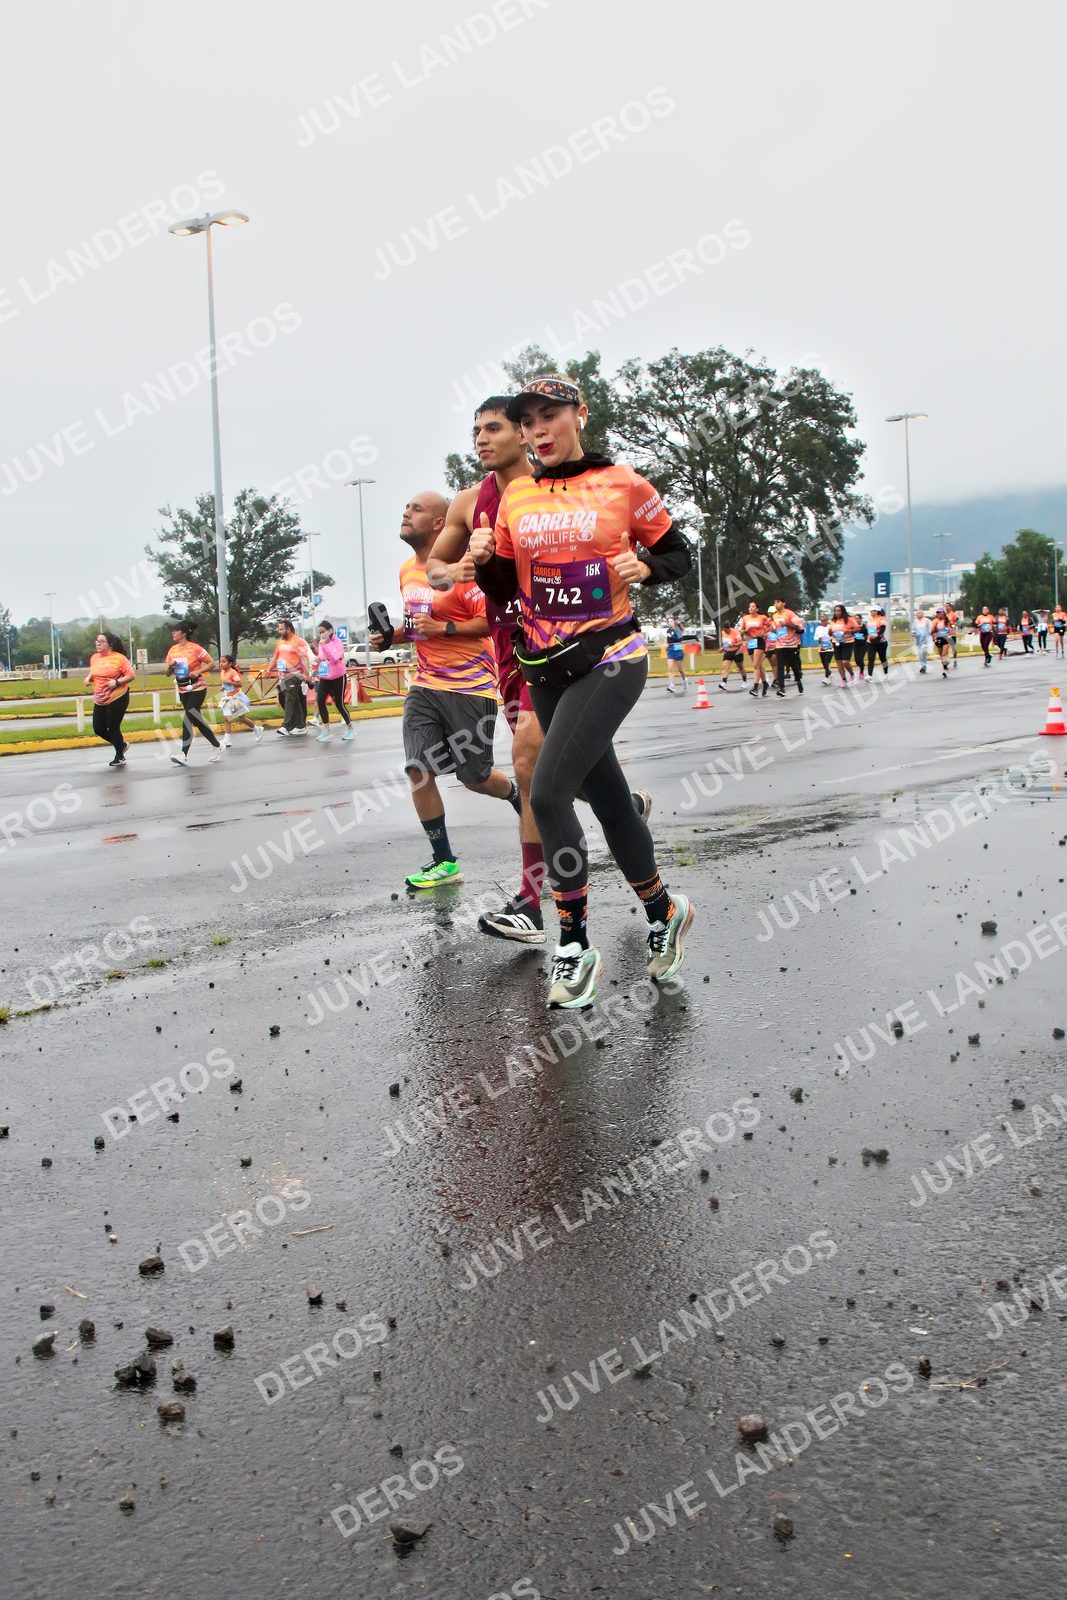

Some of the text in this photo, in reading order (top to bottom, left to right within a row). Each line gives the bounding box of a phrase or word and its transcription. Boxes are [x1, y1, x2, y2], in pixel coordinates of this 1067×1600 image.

[518, 510, 597, 533] CARRERA
[533, 565, 561, 577] CARRERA
[877, 582, 887, 595] E
[545, 588, 582, 605] 742
